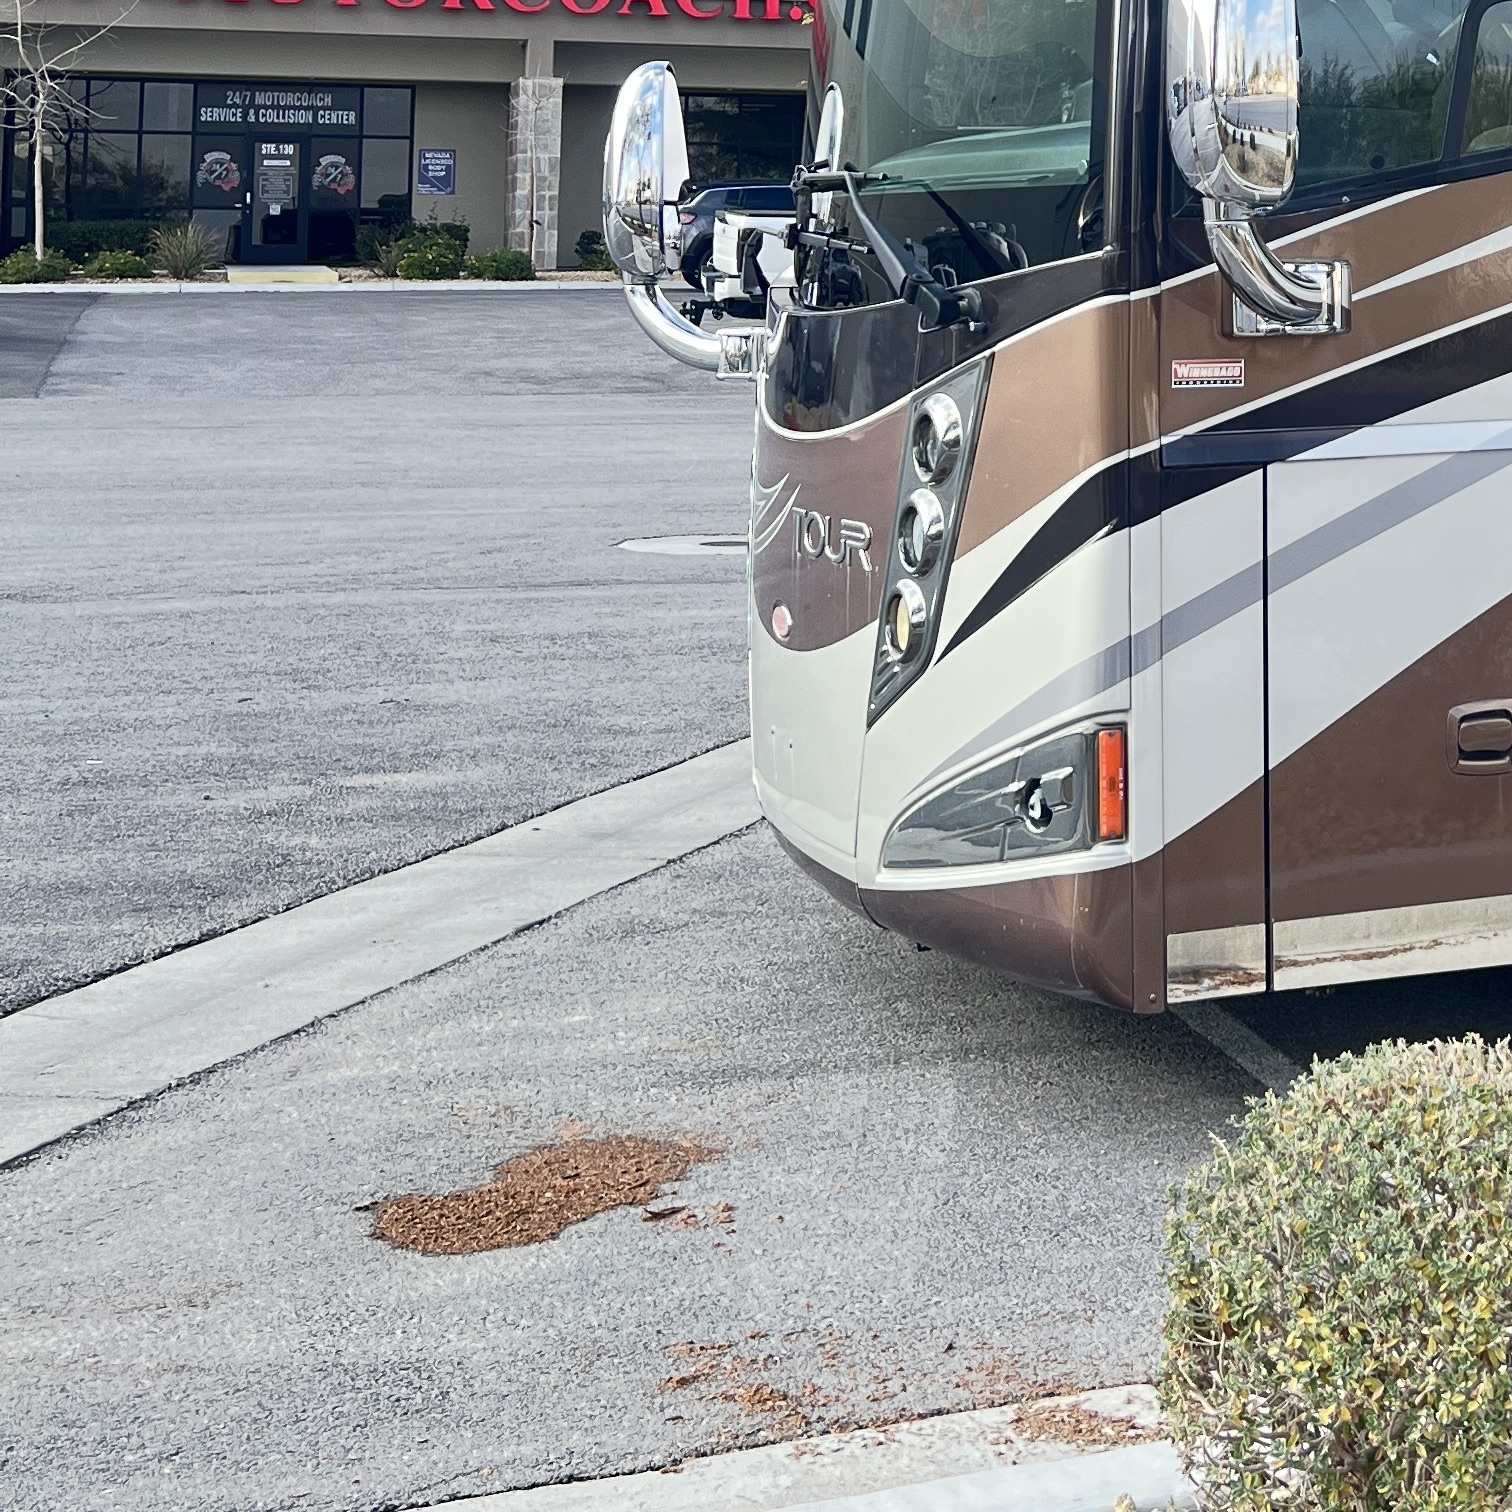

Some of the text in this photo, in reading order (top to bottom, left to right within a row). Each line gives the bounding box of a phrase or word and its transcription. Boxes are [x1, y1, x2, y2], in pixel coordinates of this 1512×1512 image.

[226, 91, 332, 107] 24/7 MOTORCOACH
[200, 107, 356, 125] SERVICE & COLLISION CENTER
[792, 505, 873, 573] TOUR
